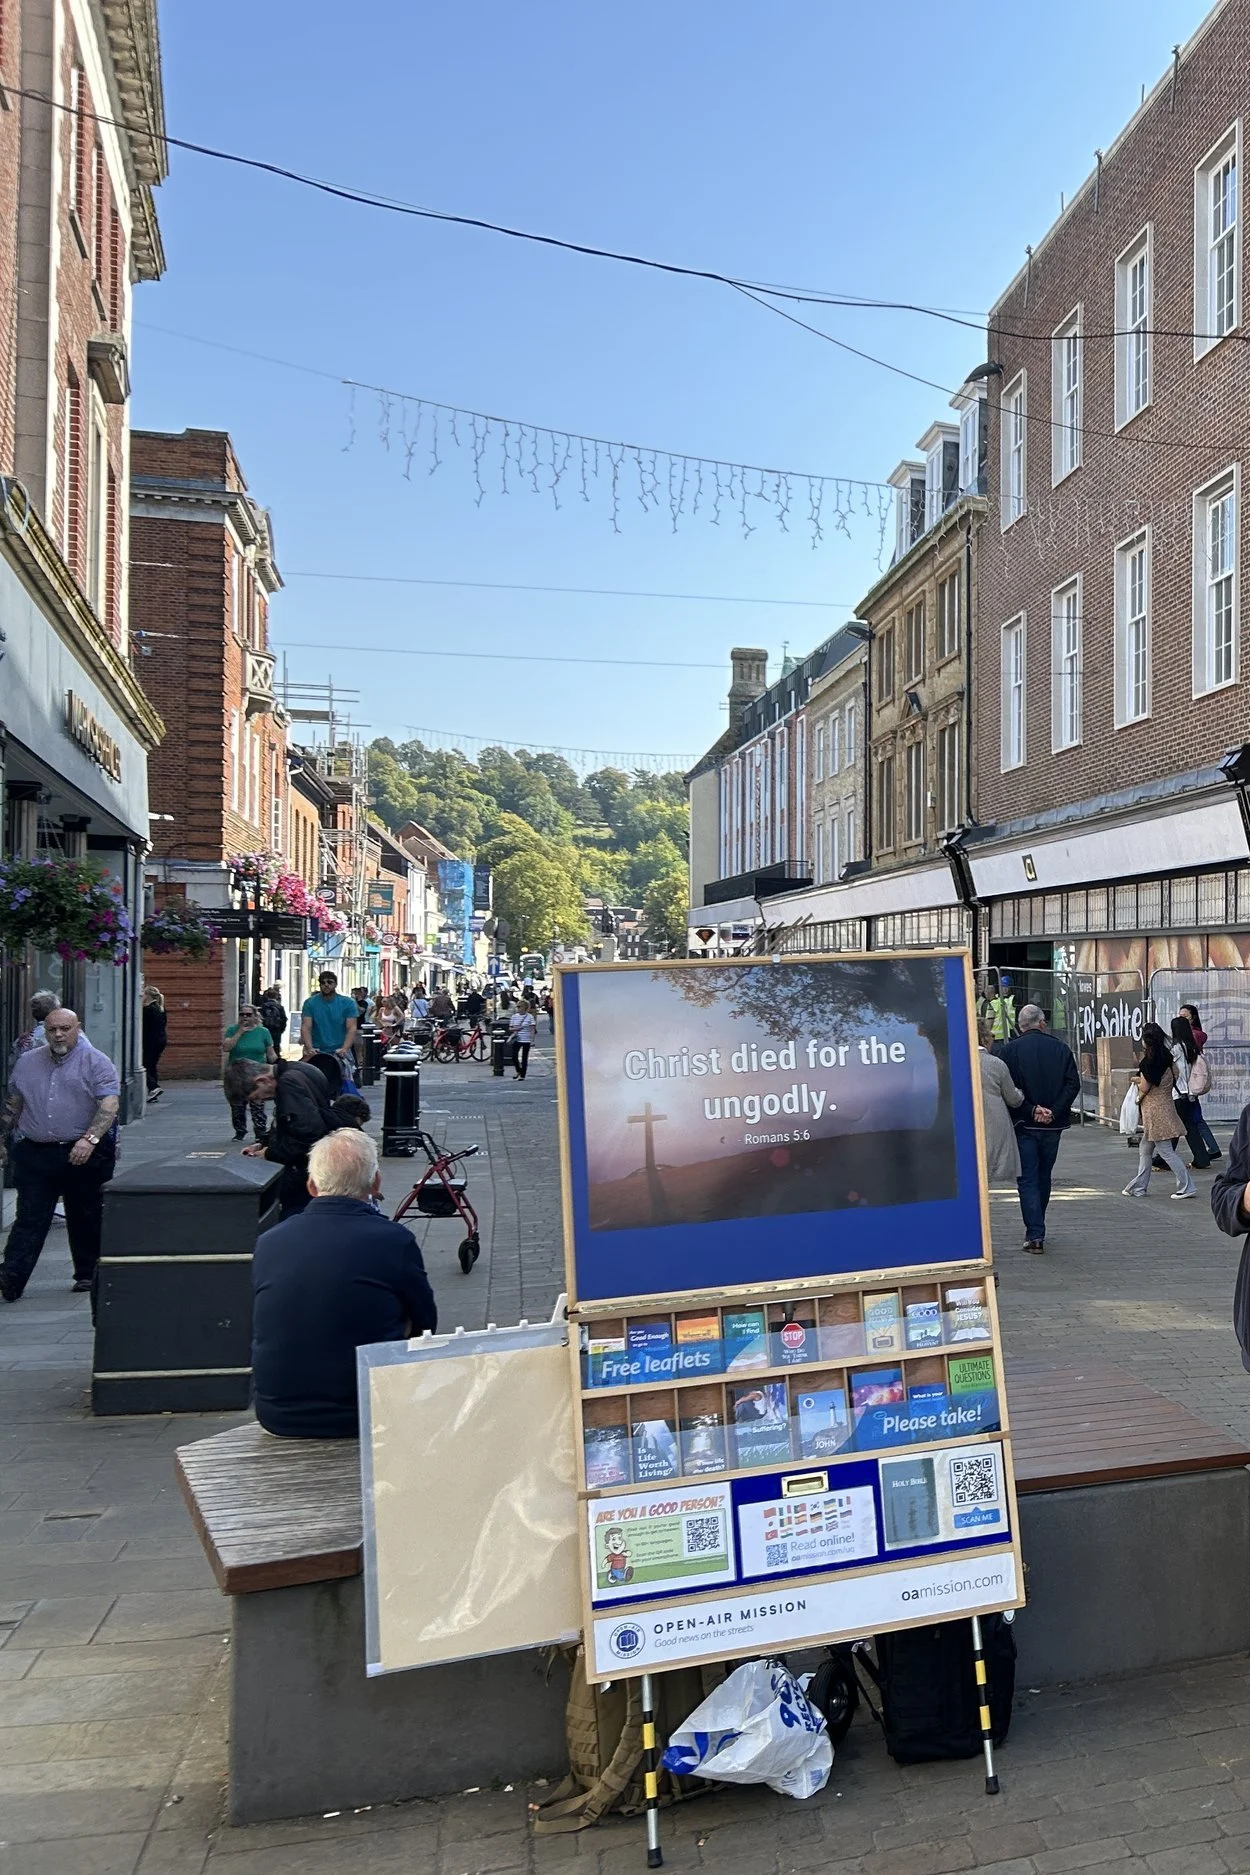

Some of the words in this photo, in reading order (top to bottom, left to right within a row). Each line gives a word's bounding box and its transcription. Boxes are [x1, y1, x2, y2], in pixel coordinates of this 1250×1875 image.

[624, 1046, 723, 1081] Christ
[731, 1041, 795, 1074] died
[806, 1038, 851, 1069] for
[858, 1035, 907, 1065] the
[704, 1084, 838, 1124] ungodly.
[745, 1132, 790, 1145] Romans
[793, 1129, 810, 1141] 5:6
[911, 1309, 938, 1318] GOOD
[955, 1305, 982, 1313] Consider
[956, 1312, 982, 1321] JESUS?
[630, 1334, 647, 1342] Good
[647, 1332, 670, 1341] Enough
[746, 1327, 760, 1335] find
[783, 1331, 803, 1342] STOP
[601, 1360, 641, 1379] Free
[644, 1351, 711, 1373] leaflets
[960, 1360, 990, 1373] ULTIMATE
[954, 1370, 991, 1383] QUESTIONS
[883, 1415, 937, 1434] Please
[940, 1404, 981, 1426] take!
[752, 1423, 787, 1433] Suffering?
[815, 1440, 836, 1449] JOHN
[638, 1454, 657, 1462] Life
[639, 1460, 669, 1470] Worth
[639, 1468, 673, 1478] Living?
[892, 1480, 910, 1488] HOLY
[596, 1509, 617, 1523] ARE
[618, 1507, 638, 1520] YOU
[639, 1505, 647, 1518] A
[649, 1502, 678, 1516] GOOD
[680, 1495, 725, 1512] PERSON?
[961, 1515, 979, 1525] SCAN
[980, 1513, 993, 1521] ME
[790, 1540, 817, 1552] Read
[819, 1533, 855, 1547] online!
[901, 1574, 1003, 1601] oamission.com
[654, 1612, 733, 1634] OPEN-AIR
[740, 1600, 807, 1620] MISSION
[654, 1637, 677, 1648] Good
[678, 1634, 700, 1644] news
[700, 1632, 712, 1640] on
[712, 1628, 727, 1638] the
[728, 1624, 754, 1636] streets
